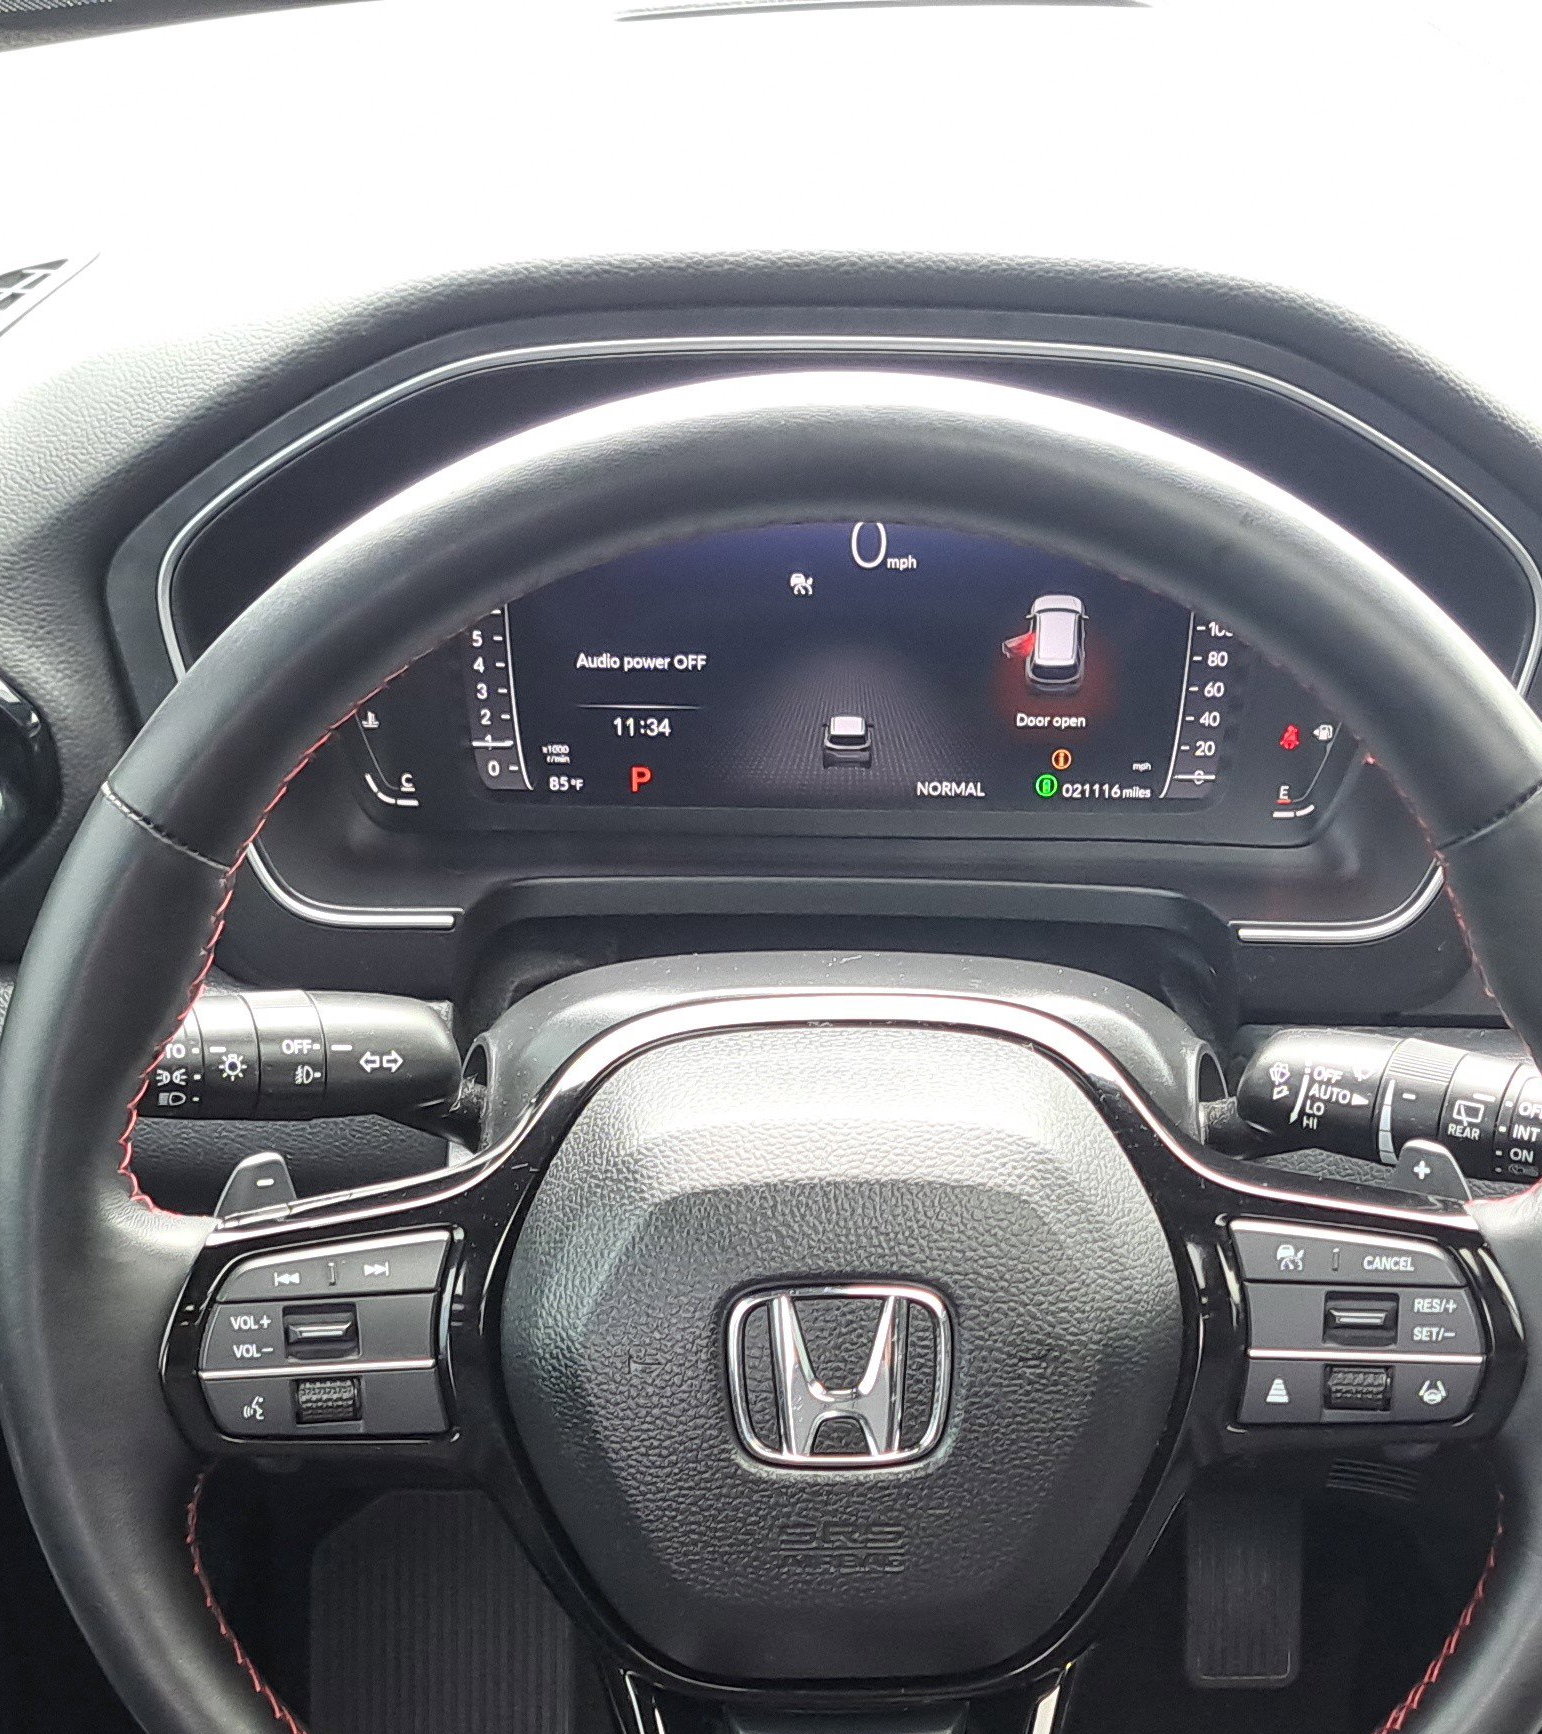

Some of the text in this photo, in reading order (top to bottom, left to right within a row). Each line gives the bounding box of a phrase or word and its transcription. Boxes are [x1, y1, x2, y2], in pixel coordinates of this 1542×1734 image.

[851, 521, 917, 571] 0 mph
[472, 630, 483, 647] 5
[473, 656, 485, 673] 4
[576, 653, 707, 672] Audio power OFF
[1207, 651, 1228, 667] 80
[476, 683, 488, 699] 3
[1204, 682, 1225, 697] 60
[480, 709, 492, 725] 2
[1016, 712, 1086, 730] Door open
[1199, 711, 1221, 727] 40
[613, 716, 672, 737] 11:34
[1195, 741, 1216, 756] 20
[487, 760, 500, 777] 0
[401, 773, 413, 788] C
[630, 765, 652, 793] P
[916, 781, 985, 798] NORMAL
[1062, 784, 1151, 799] 021116 miles
[1279, 785, 1290, 800] E
[282, 1039, 312, 1055] OFF
[1313, 1065, 1344, 1084] OFF
[1308, 1082, 1351, 1104] AUTO
[1305, 1099, 1325, 1116] LO
[1302, 1115, 1318, 1130] HI
[1447, 1123, 1480, 1140] REAR
[1512, 1123, 1541, 1142] INT
[1509, 1147, 1534, 1164] ON
[1363, 1255, 1415, 1272] CANCEL
